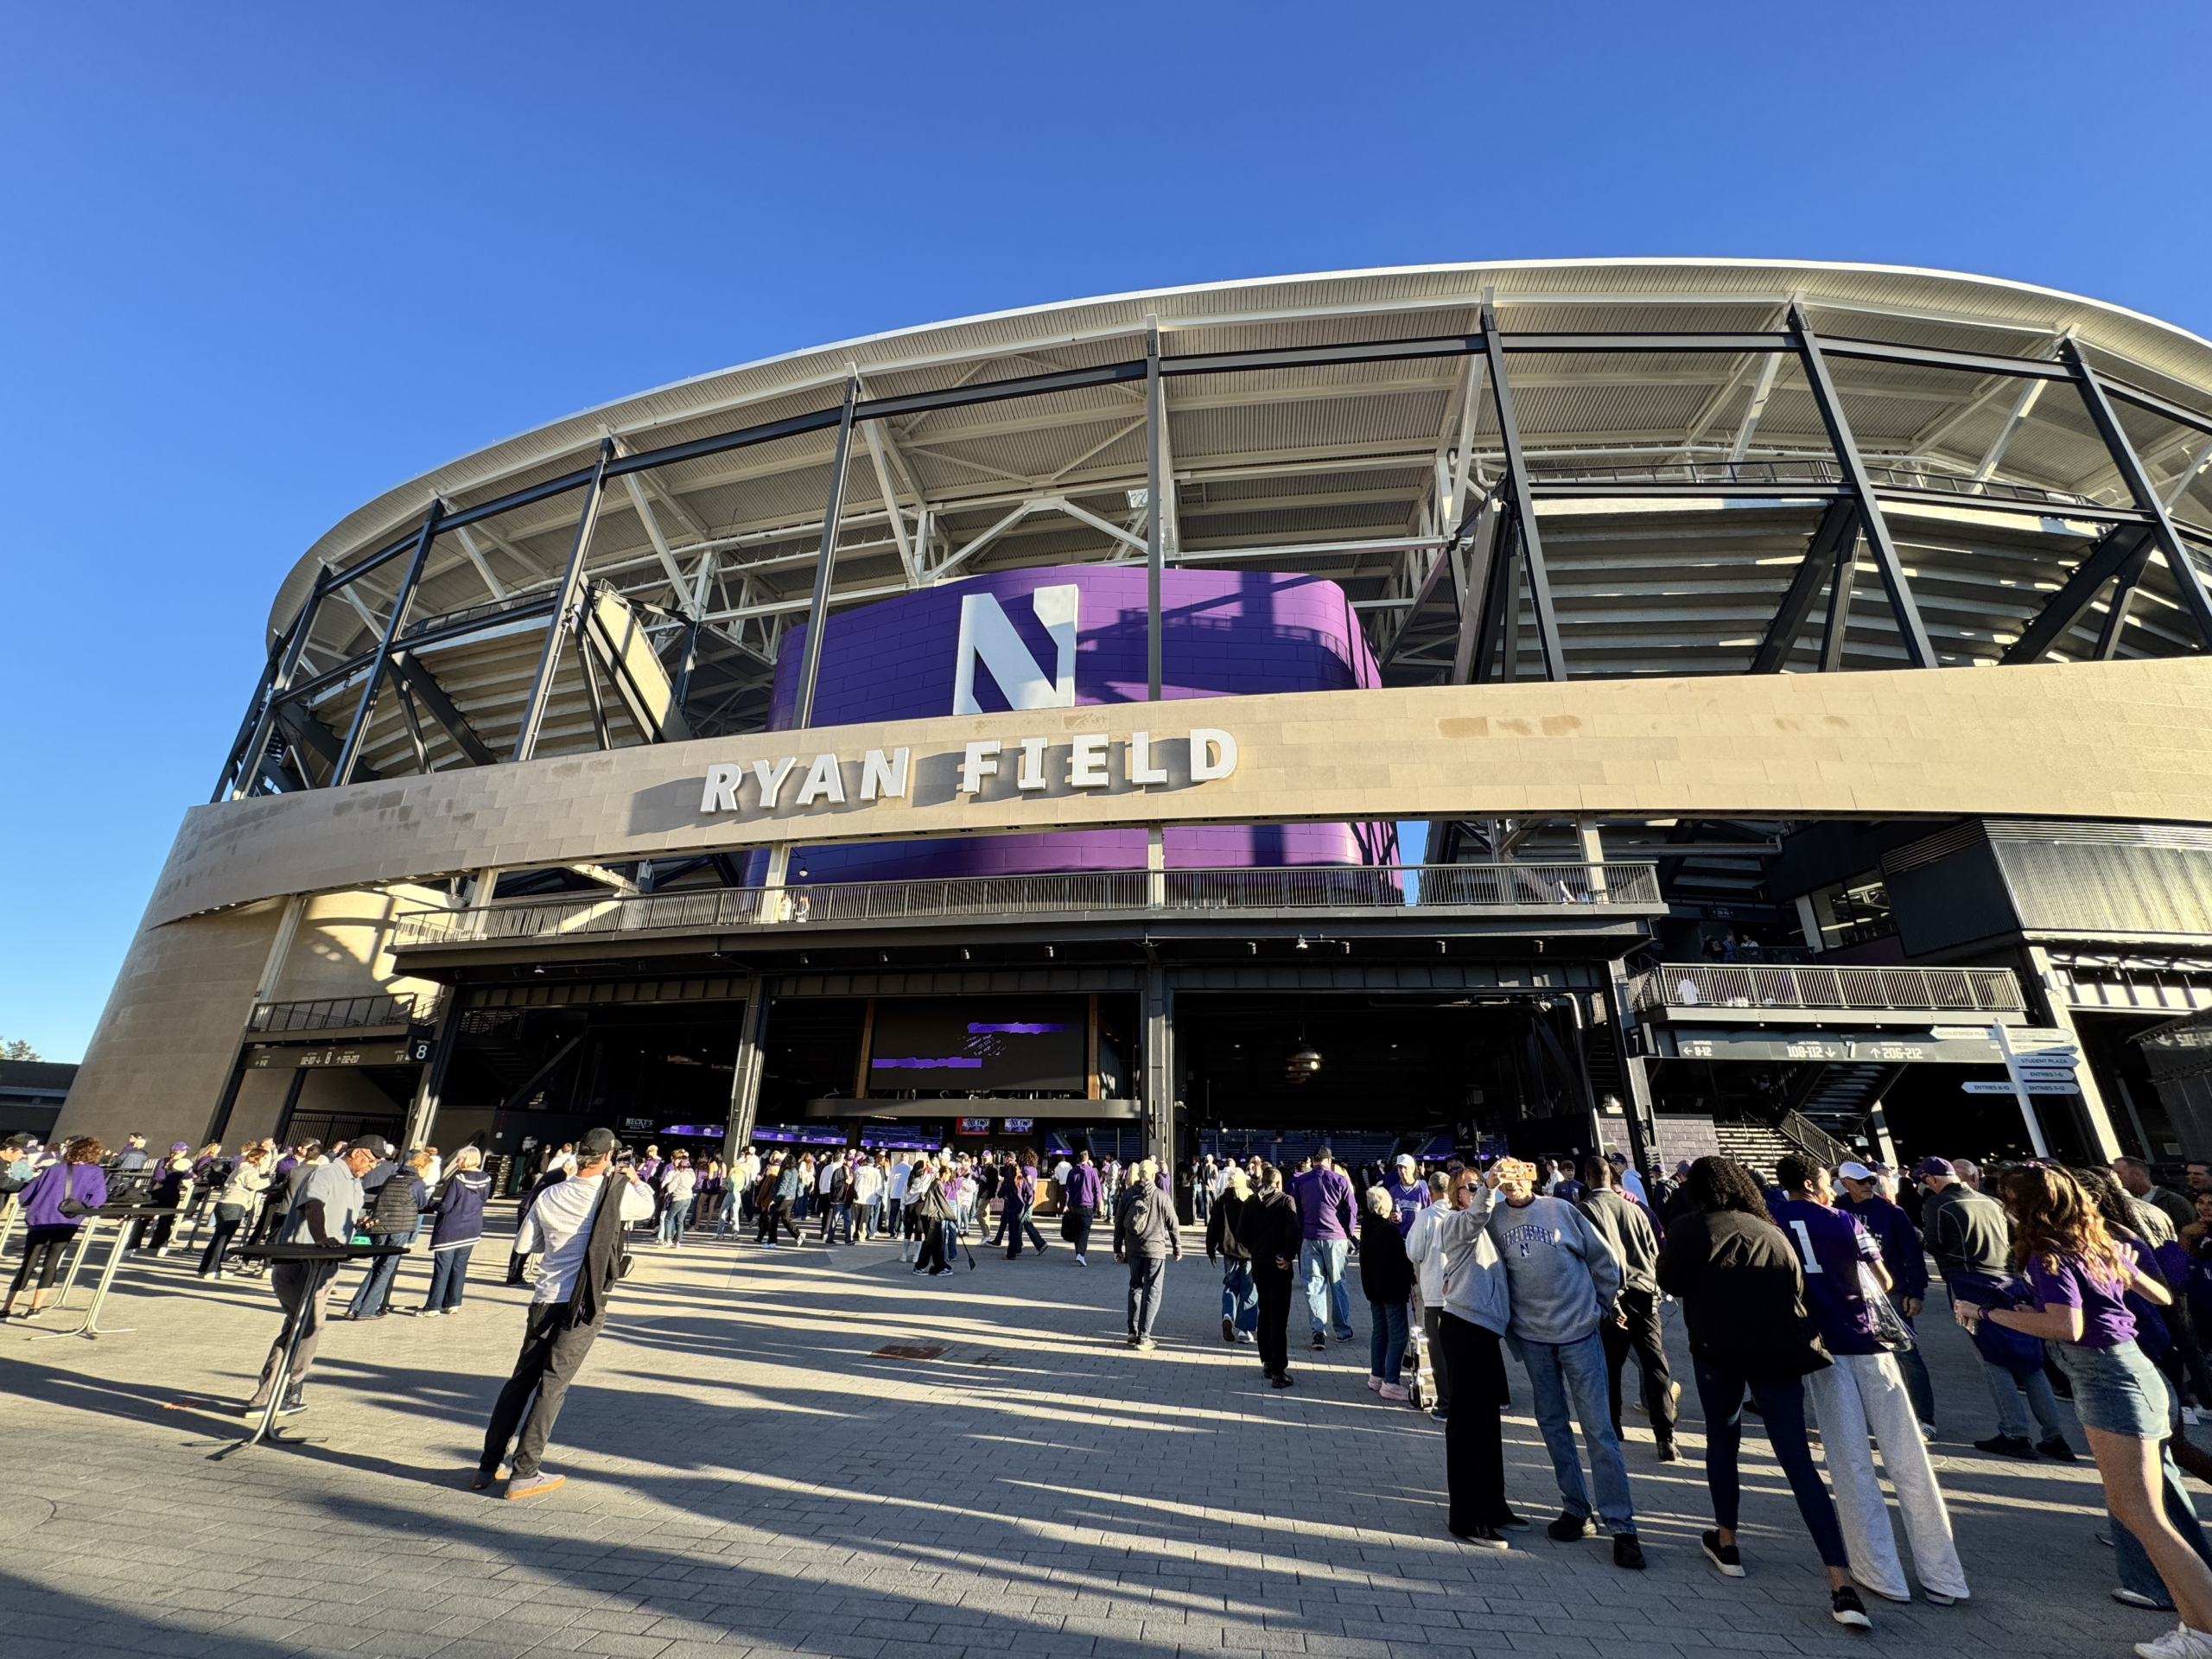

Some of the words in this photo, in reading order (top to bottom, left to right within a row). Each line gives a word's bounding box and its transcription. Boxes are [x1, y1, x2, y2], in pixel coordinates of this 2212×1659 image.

[953, 584, 1079, 716] N
[699, 747, 909, 814] RYAN
[961, 728, 1237, 794] FIELD
[1632, 1034, 1639, 1053] 7
[1846, 1040, 1857, 1058] 7
[325, 1052, 333, 1064] 8
[416, 1045, 428, 1059] 8
[1694, 1046, 1713, 1057] 8-12
[1786, 1046, 1824, 1058] 108-112
[1881, 1047, 1924, 1059] 206-212
[626, 1117, 654, 1128] HECKY'S
[1789, 1220, 1824, 1274] 1
